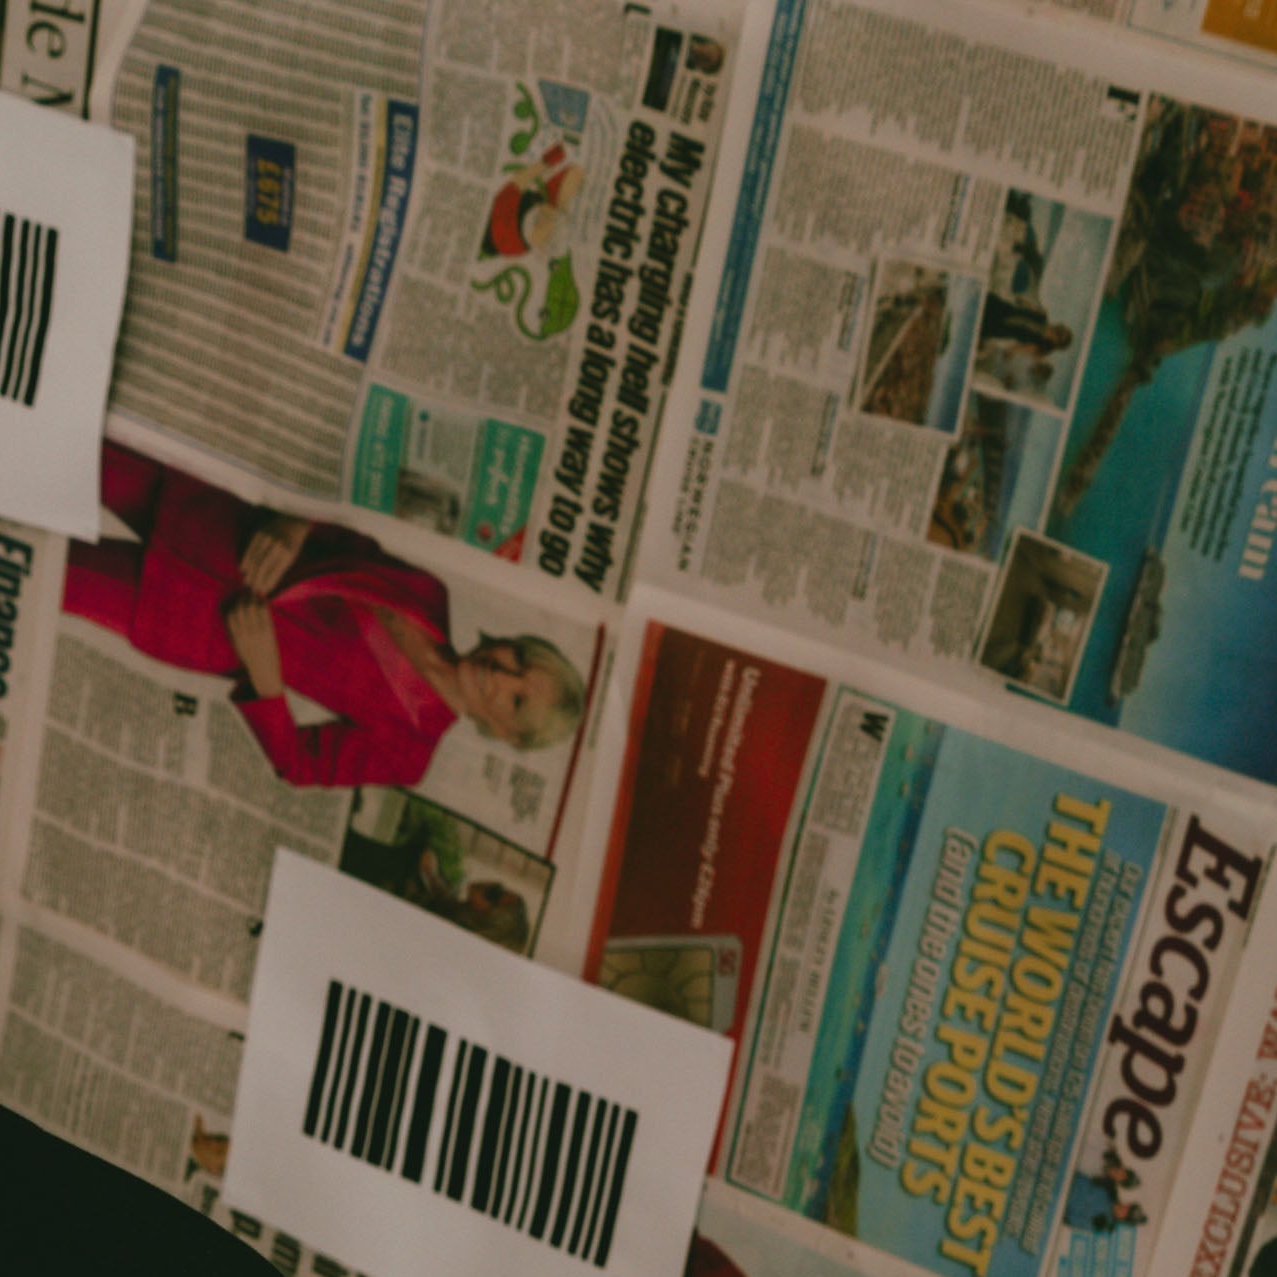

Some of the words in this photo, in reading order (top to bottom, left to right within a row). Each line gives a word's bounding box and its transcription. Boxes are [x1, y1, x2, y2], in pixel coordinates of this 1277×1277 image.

[601, 121, 656, 259] electric
[659, 132, 704, 188] My
[590, 259, 632, 324] has
[627, 188, 688, 344] charging
[567, 349, 613, 426] long
[616, 343, 658, 414] hell
[554, 426, 593, 496] way
[591, 410, 639, 519] shows
[547, 495, 581, 532] to
[537, 532, 570, 577] go
[573, 521, 614, 592] why
[1036, 794, 1110, 906] THE
[921, 904, 960, 961] the
[945, 830, 1035, 1028] CRUISE
[901, 957, 944, 1038] ones
[975, 908, 1077, 1146] WORLD'S
[1103, 819, 1261, 1157] Escape
[893, 1035, 928, 1074] to
[903, 1024, 987, 1200] PORTS
[943, 1143, 1014, 1275] BEST
